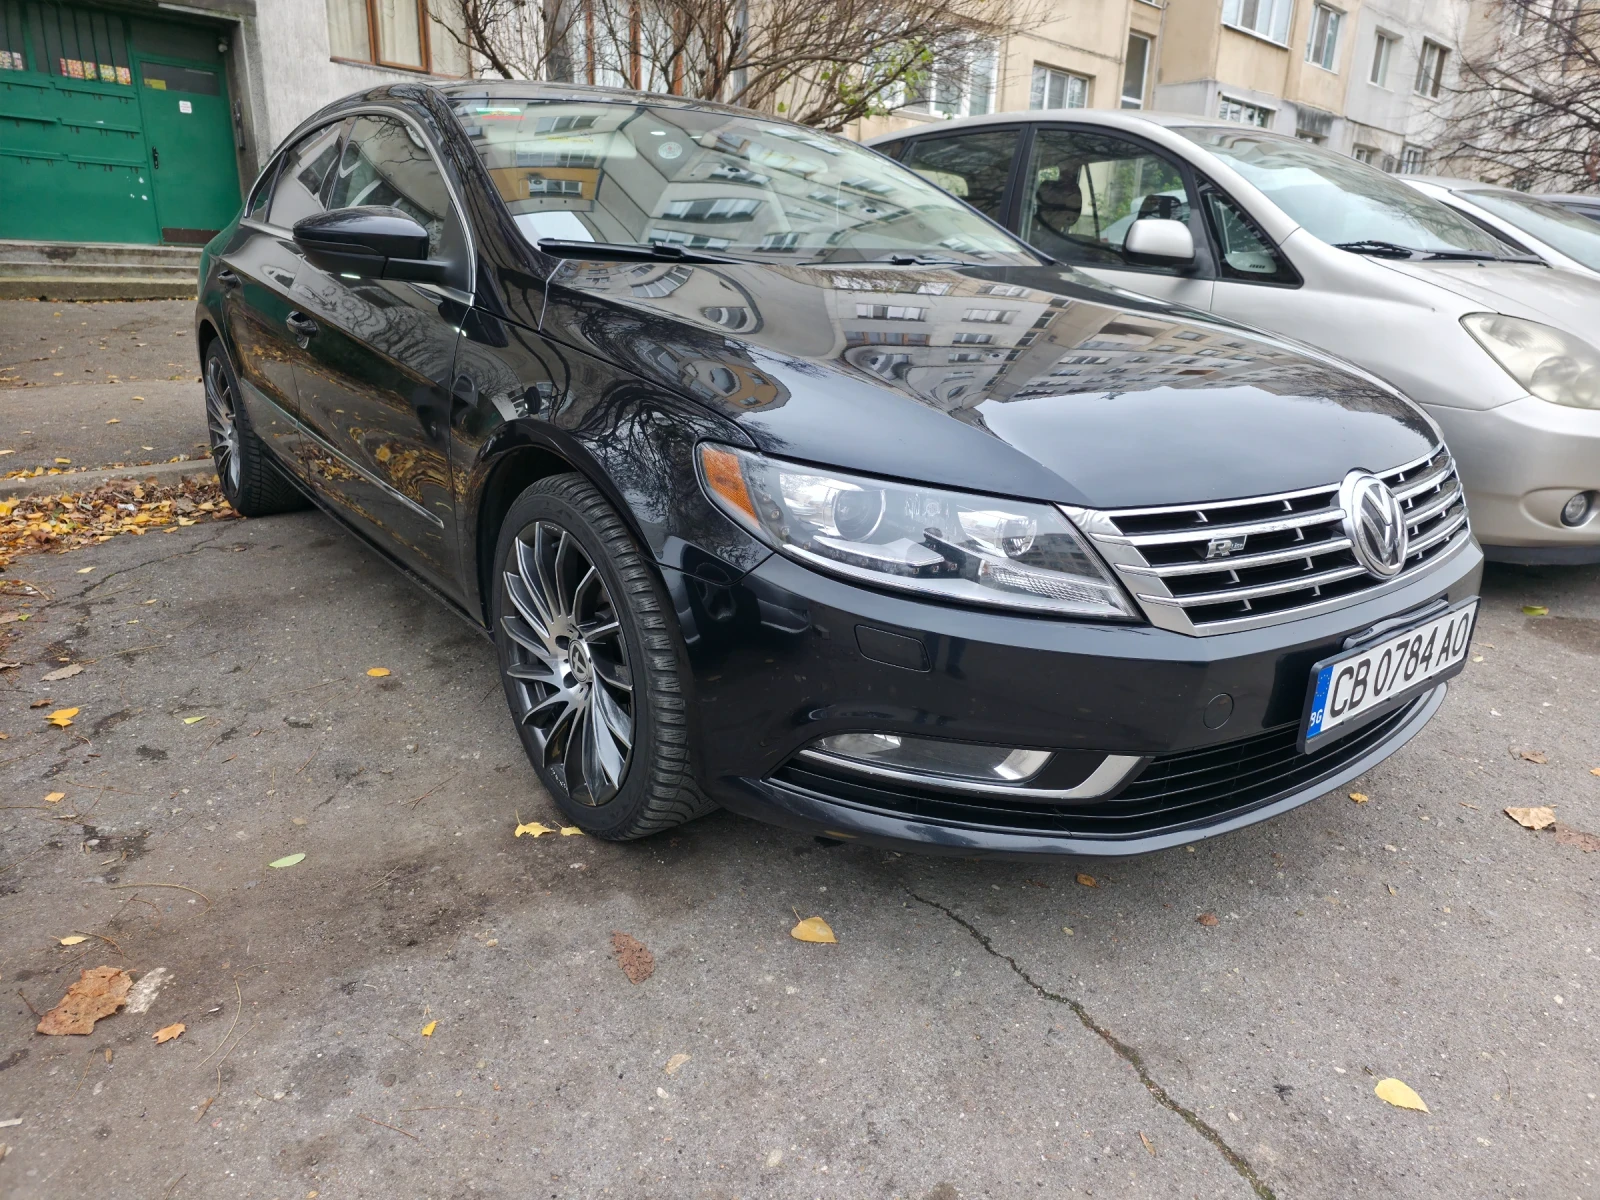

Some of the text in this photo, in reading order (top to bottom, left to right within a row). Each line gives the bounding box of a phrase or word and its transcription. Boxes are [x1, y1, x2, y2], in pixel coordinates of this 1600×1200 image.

[1330, 612, 1470, 718] CB 0784 AO
